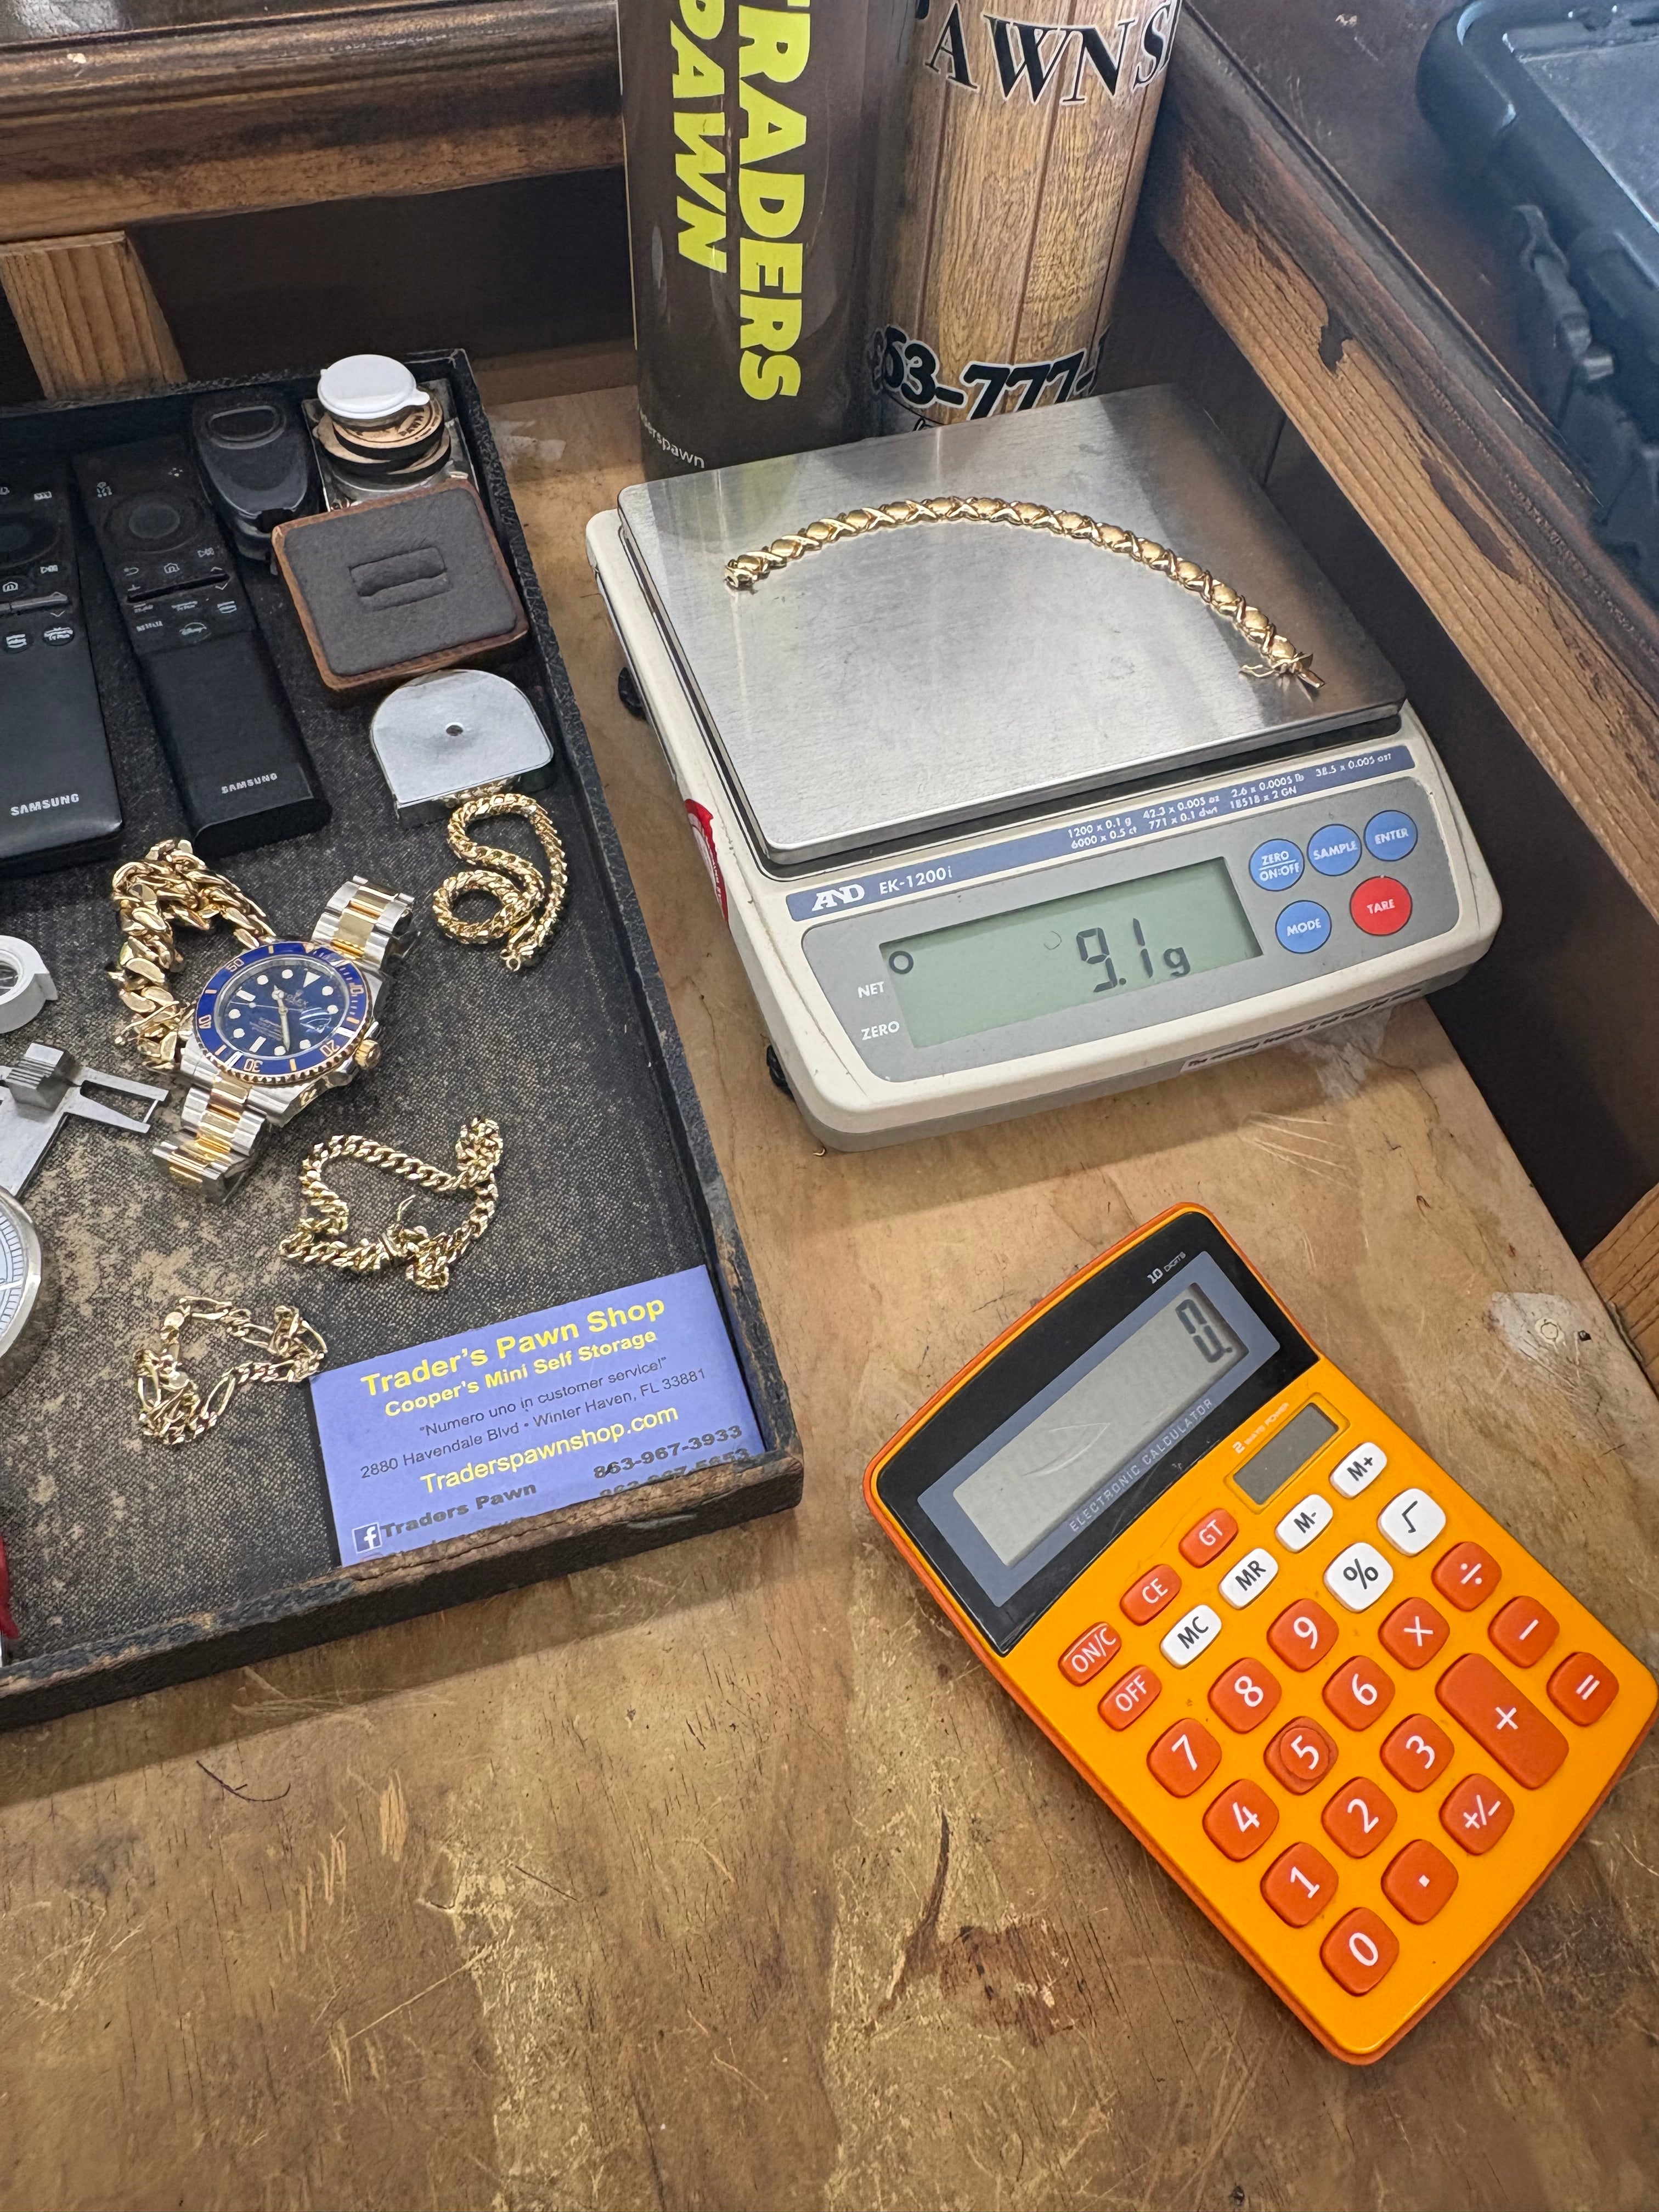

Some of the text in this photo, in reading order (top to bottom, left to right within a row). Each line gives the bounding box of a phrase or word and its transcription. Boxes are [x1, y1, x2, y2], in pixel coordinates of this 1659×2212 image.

[739, 0, 810, 401] RADERS
[221, 772, 278, 795] SAMSUNG
[10, 793, 80, 817] SAMSUNG
[1071, 835, 1098, 850] 6000
[1109, 828, 1126, 840] 0.5
[1148, 817, 1167, 830] 771
[1180, 810, 1195, 822] 0.1
[1271, 790, 1279, 799] 2
[1068, 824, 1093, 839] 1200
[1105, 817, 1121, 830] 0.1
[1374, 828, 1409, 845] ENTER
[1261, 851, 1290, 866] ZERO
[1313, 840, 1358, 860] SAMPLE
[879, 866, 953, 895] EK-1200i
[1366, 899, 1396, 914] TARE
[1286, 918, 1322, 936] MODE
[857, 981, 885, 998] NET
[861, 1020, 900, 1041] ZERO
[319, 1039, 341, 1058] 20
[243, 1058, 264, 1074] 30
[1147, 1268, 1164, 1284] 10
[360, 1299, 665, 1396] Trader's Pawn Shop
[385, 1330, 657, 1417] Cooper's Mini Self Storage
[488, 1402, 517, 1419] uno
[520, 1396, 534, 1413] in
[537, 1377, 604, 1404] customer
[360, 1368, 706, 1479] 2880 Havendale Blvd Winter Haven, FL 33881
[420, 1407, 679, 1493] Traderspawnshop.com
[592, 1424, 743, 1480] 863-967-3933
[1232, 1441, 1246, 1454] 2
[1346, 1455, 1374, 1482] M+
[475, 1483, 537, 1510] Pawn
[1069, 1464, 1141, 1532] ELECTRONIC
[1198, 1519, 1227, 1547] GT
[1293, 1511, 1318, 1535] M-
[1235, 1560, 1267, 1592] MR
[1342, 1558, 1379, 1590] %
[1141, 1577, 1169, 1605] CE
[1176, 1616, 1210, 1650] MC
[1293, 1616, 1319, 1650] 9
[1070, 1627, 1118, 1674] ON/C
[1114, 1674, 1149, 1713] OFF
[1233, 1675, 1264, 1708] 8
[1351, 1673, 1378, 1707] 6
[1171, 1734, 1198, 1771] 7
[1290, 1735, 1319, 1770] 5
[1405, 1735, 1436, 1770] 3
[1232, 1801, 1261, 1833] 4
[1347, 1798, 1379, 1833] 2
[1290, 1865, 1321, 1899] 1
[1348, 1932, 1379, 1967] 0
